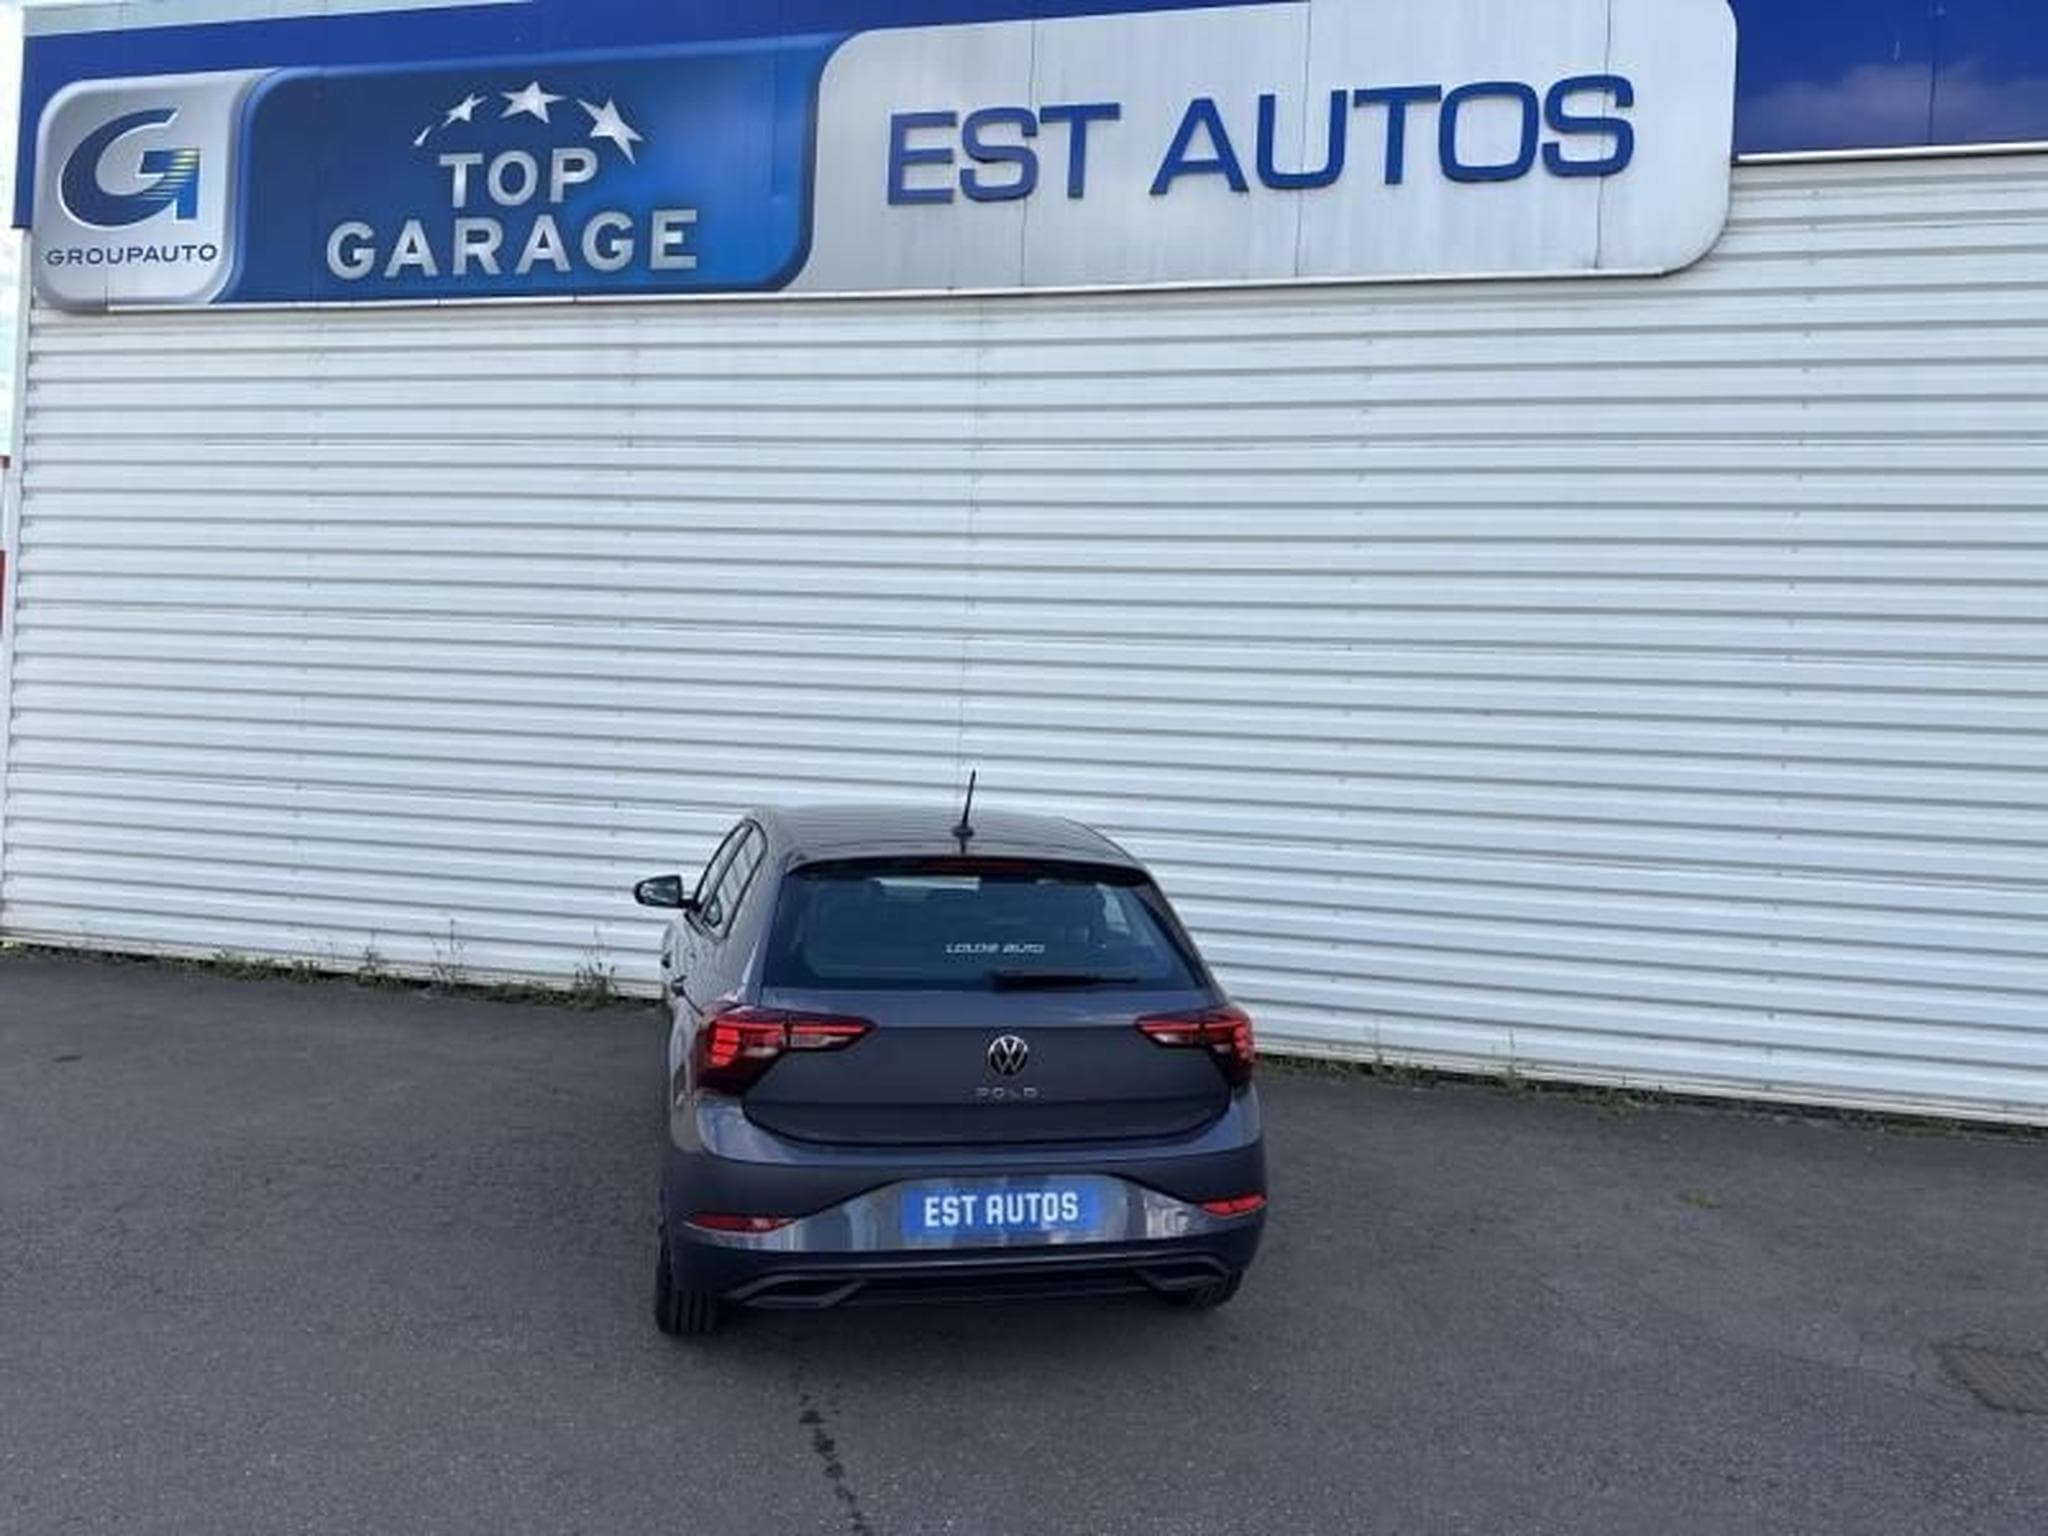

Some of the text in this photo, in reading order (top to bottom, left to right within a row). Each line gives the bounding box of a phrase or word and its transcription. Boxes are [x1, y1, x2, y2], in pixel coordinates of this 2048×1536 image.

[887, 74, 1635, 206] EST AUTOS
[439, 147, 598, 208] TOP
[46, 243, 218, 265] GROUPAUTO
[326, 208, 697, 279] GARAGE
[924, 1191, 1079, 1228] EST AUTOS
